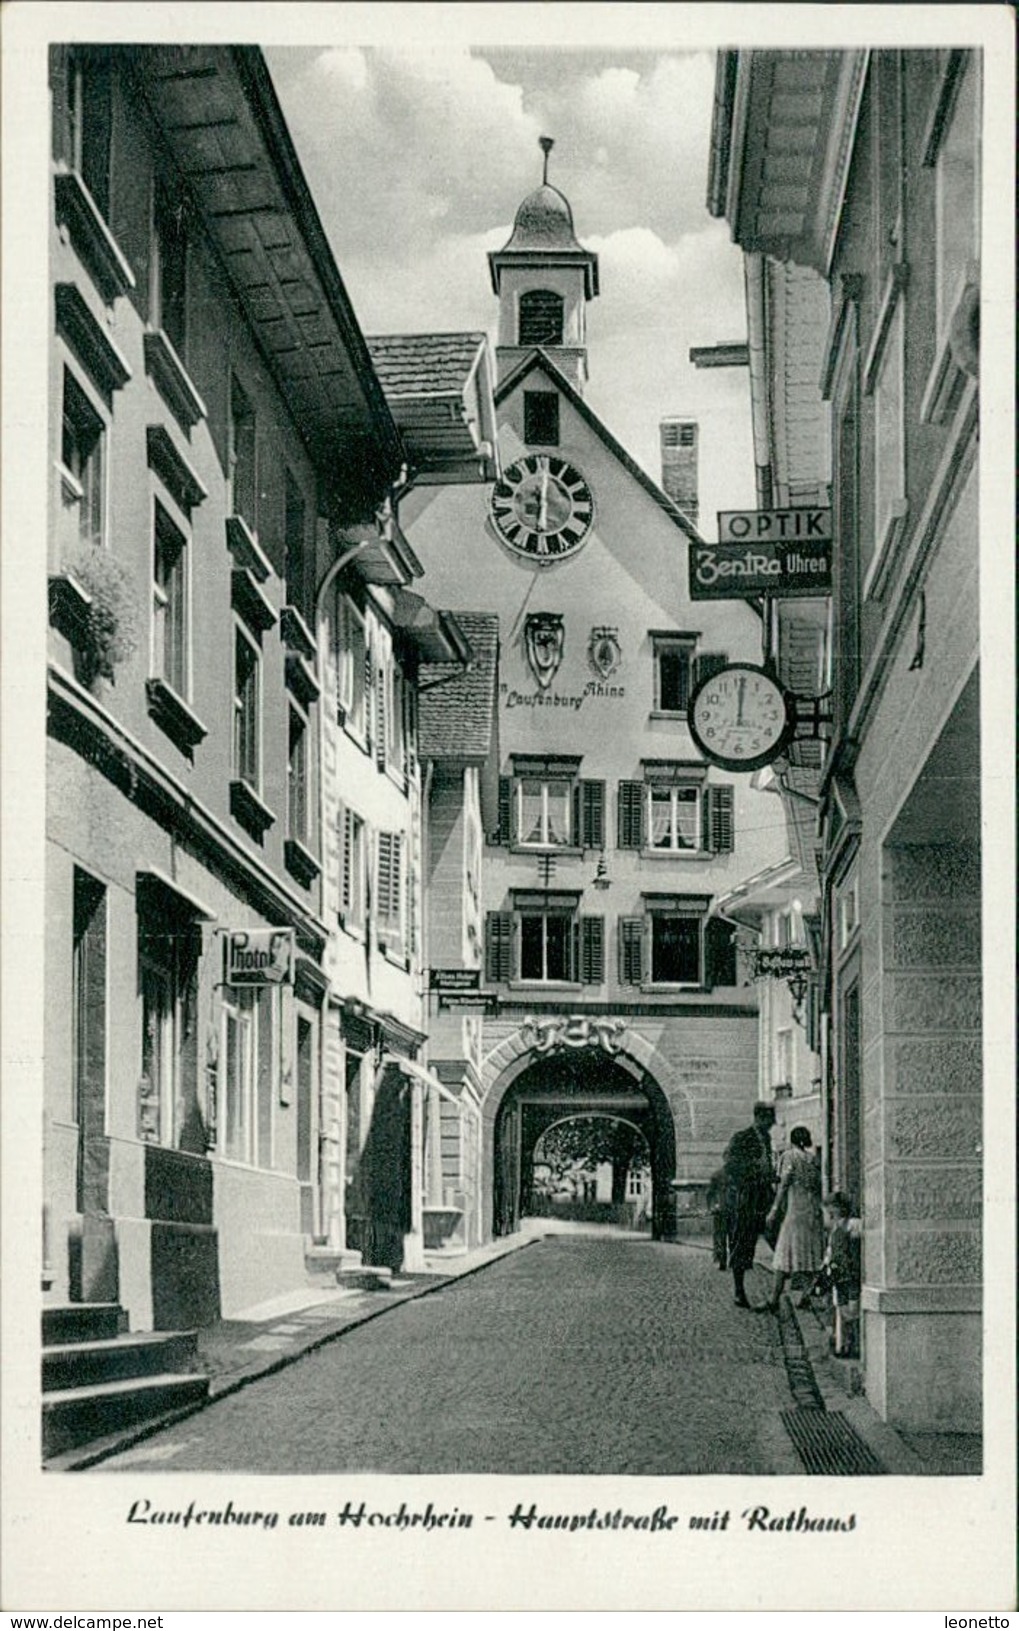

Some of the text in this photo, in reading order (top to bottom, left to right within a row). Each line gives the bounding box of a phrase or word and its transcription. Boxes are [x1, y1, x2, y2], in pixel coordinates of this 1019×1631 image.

[729, 513, 825, 538] OPTIK
[787, 553, 828, 574] Uhren
[506, 691, 584, 711] Laufenburg
[126, 1500, 279, 1530] Laufenburg
[288, 1511, 327, 1528] am
[338, 1502, 474, 1531] Hochrhein
[508, 1503, 679, 1532] Hauptstraße
[689, 1510, 731, 1531] mit
[741, 1506, 858, 1532] Rathaus
